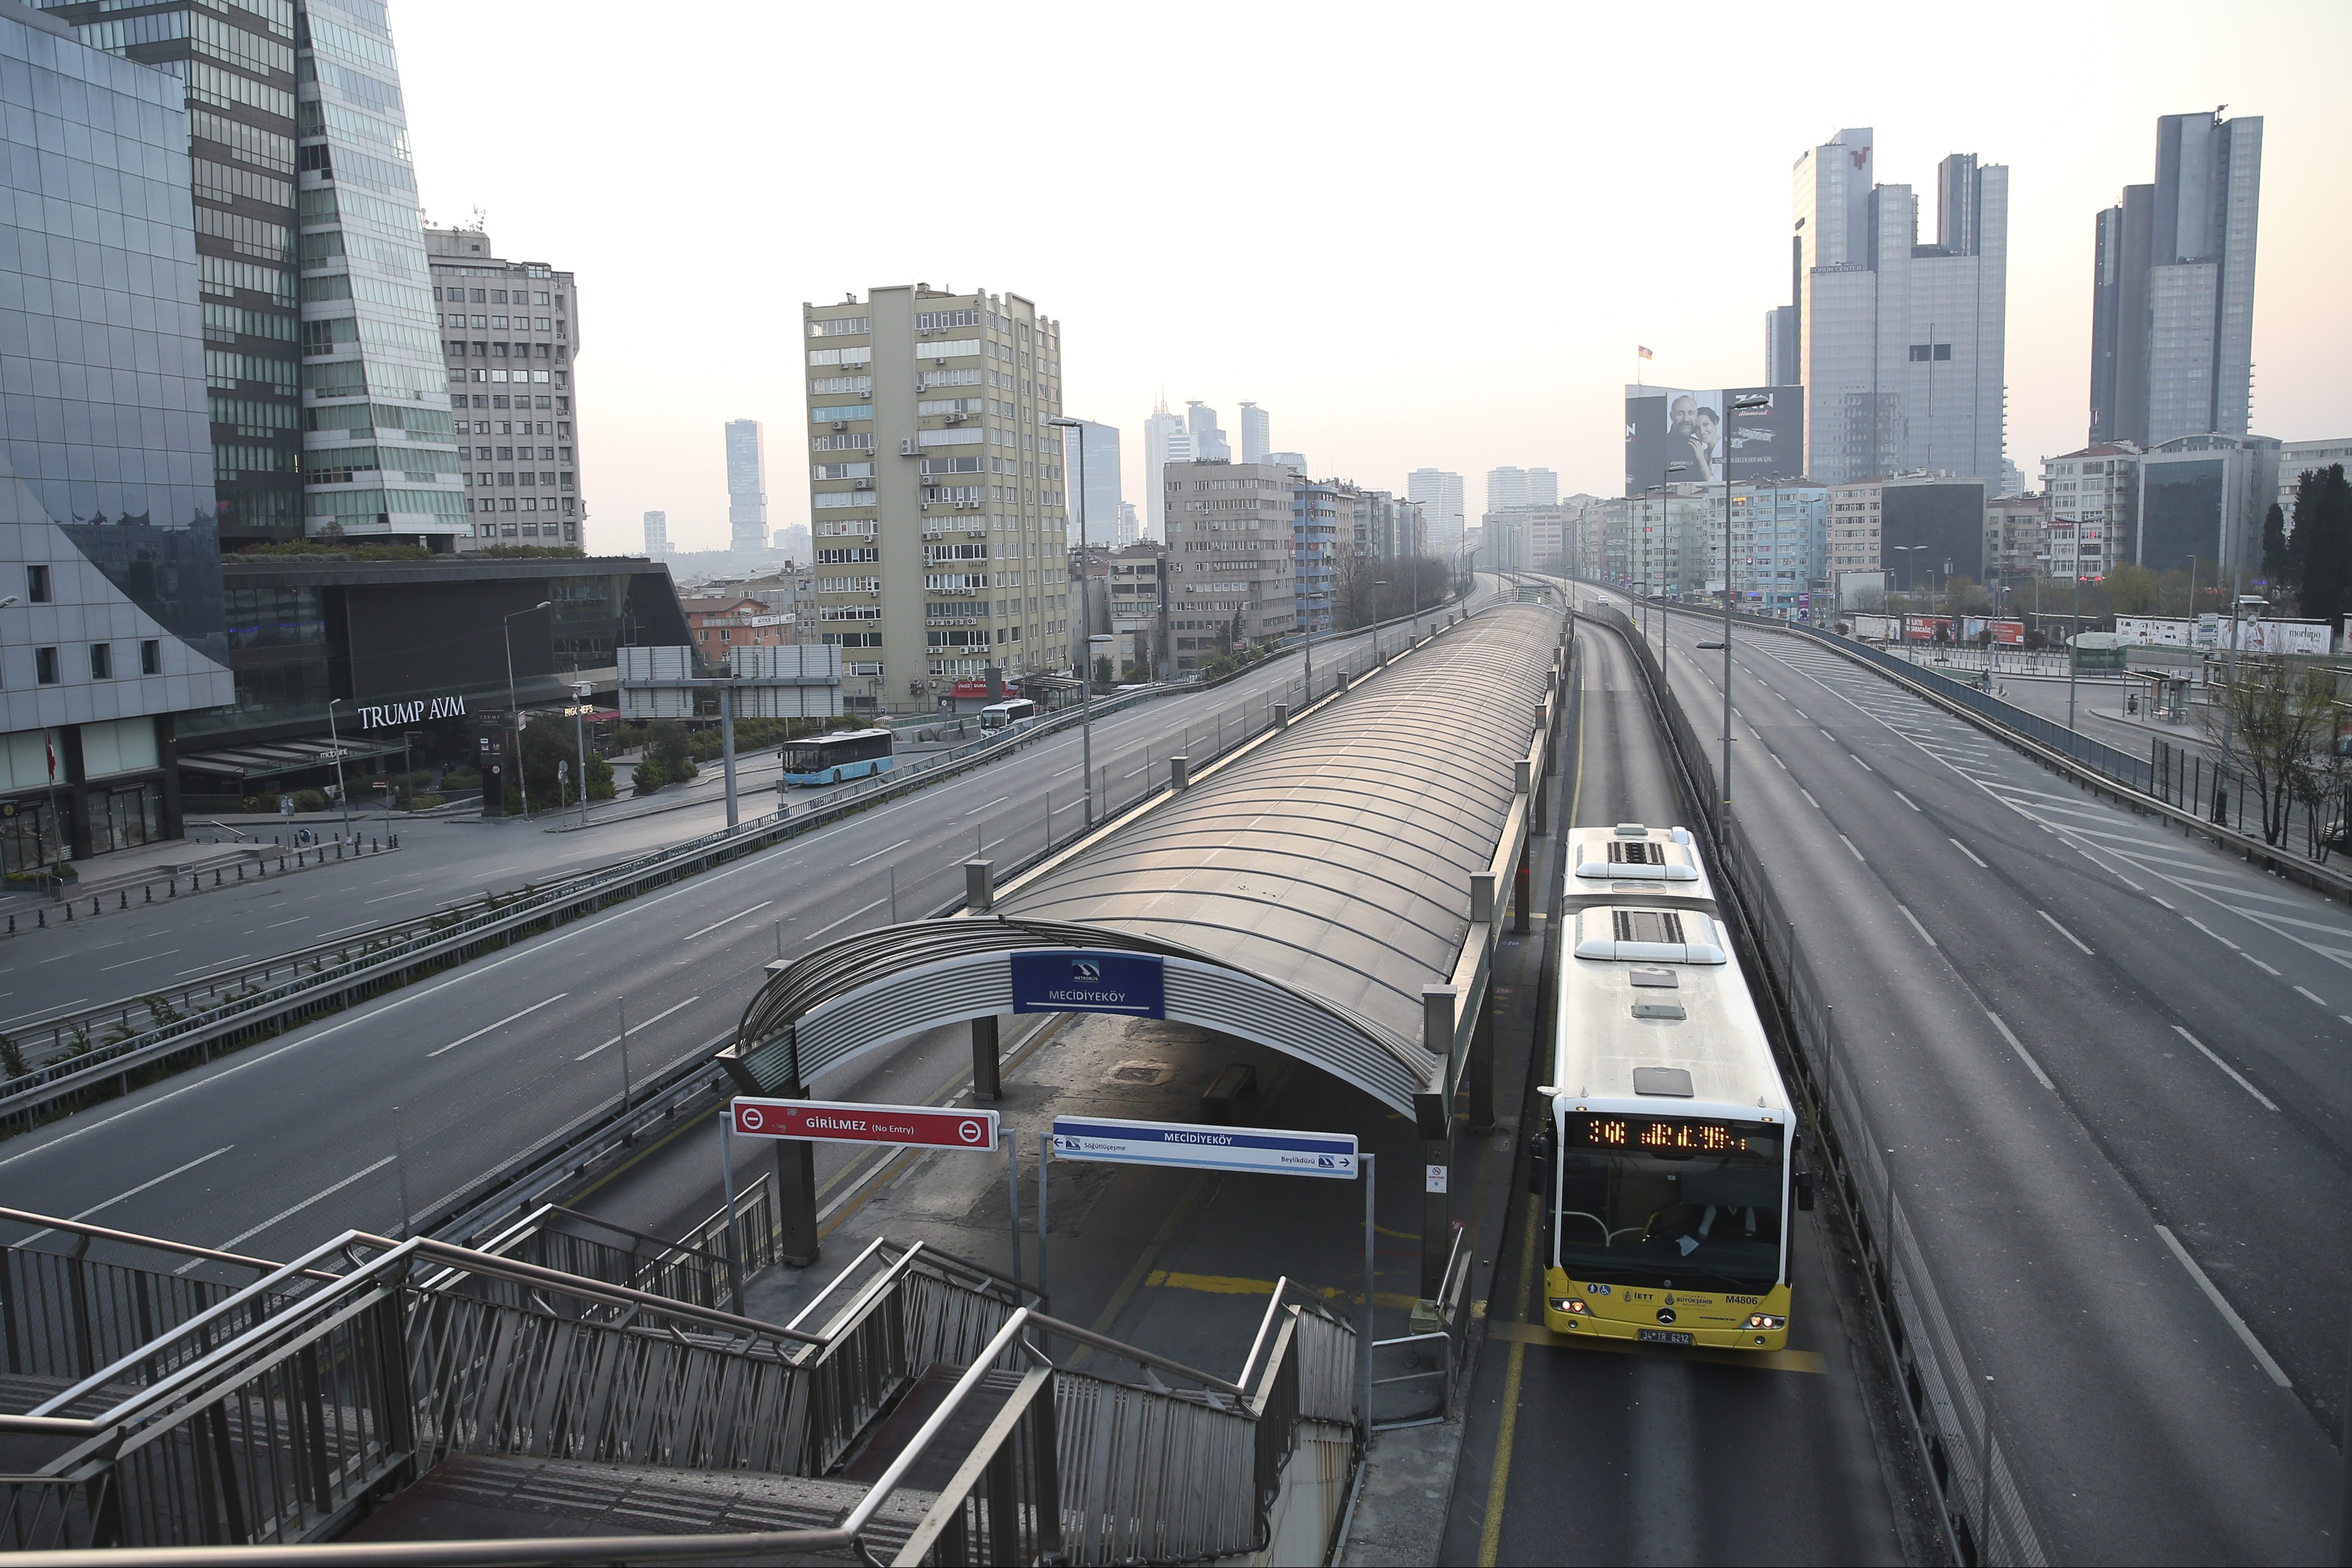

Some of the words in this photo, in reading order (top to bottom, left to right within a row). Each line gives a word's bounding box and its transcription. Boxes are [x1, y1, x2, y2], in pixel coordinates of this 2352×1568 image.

[2290, 627, 2321, 642] morhipo
[2179, 638, 2201, 646] VIVENS
[358, 700, 425, 730] TRUMP
[429, 695, 466, 720] AVM
[1049, 989, 1126, 1002] MECİDİYEKÖY
[806, 1116, 867, 1131] GİRİLMEZ
[872, 1124, 888, 1133] (No
[889, 1125, 915, 1135] Entry)
[1164, 1132, 1232, 1145] MECİDİYEKÖY
[1084, 1142, 1126, 1151] Söğütlüçeşme
[1281, 1156, 1315, 1164] Beylikdüzü
[1634, 1291, 1653, 1300] İETT
[1676, 1296, 1713, 1305] BÜYÜKŞEHİR
[1725, 1295, 1758, 1305] M4806
[1642, 1331, 1652, 1340] 34
[1658, 1332, 1667, 1341] TR
[1671, 1334, 1689, 1342] 6212
